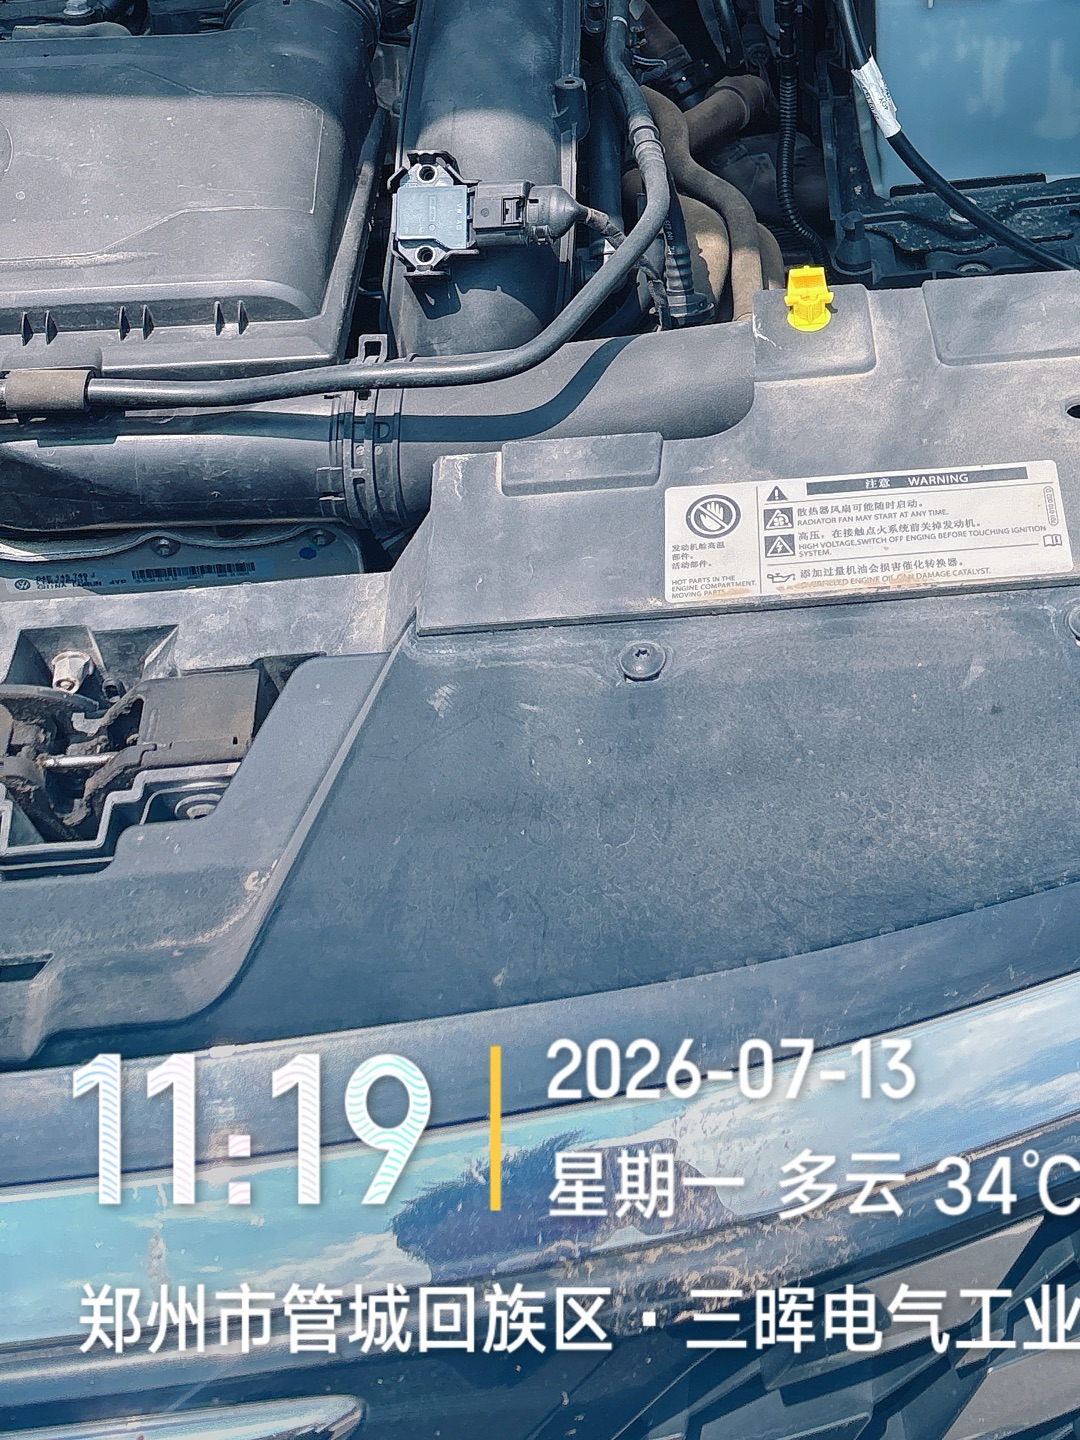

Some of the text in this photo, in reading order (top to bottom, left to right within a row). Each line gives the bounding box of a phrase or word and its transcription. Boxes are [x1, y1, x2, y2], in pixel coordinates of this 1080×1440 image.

[865, 473, 969, 489] 注意 WARNING
[797, 499, 923, 517] 散热器风扇可能随时启动。
[798, 517, 836, 526] RADIATOR
[856, 514, 872, 522] MAY
[874, 512, 897, 520] START
[798, 542, 819, 551] HIGH
[889, 535, 903, 543] OFF
[938, 531, 967, 539] BEFORE
[969, 528, 1010, 537] TOUCHING
[1011, 525, 1046, 534] IGNITION
[672, 541, 725, 552] 发动机舱高温
[672, 553, 693, 561] 部件。
[799, 549, 832, 558] SYSTEM.
[672, 560, 712, 570] 活动部件。
[800, 557, 963, 579] 添加过量机油会损害催化转换器。
[851, 576, 880, 585] ENGINE
[916, 569, 951, 580] DAMAGE
[953, 567, 992, 577] CATALYST.
[672, 578, 686, 586] HOT
[672, 584, 698, 592] ENGINE
[672, 590, 702, 599] MOVING
